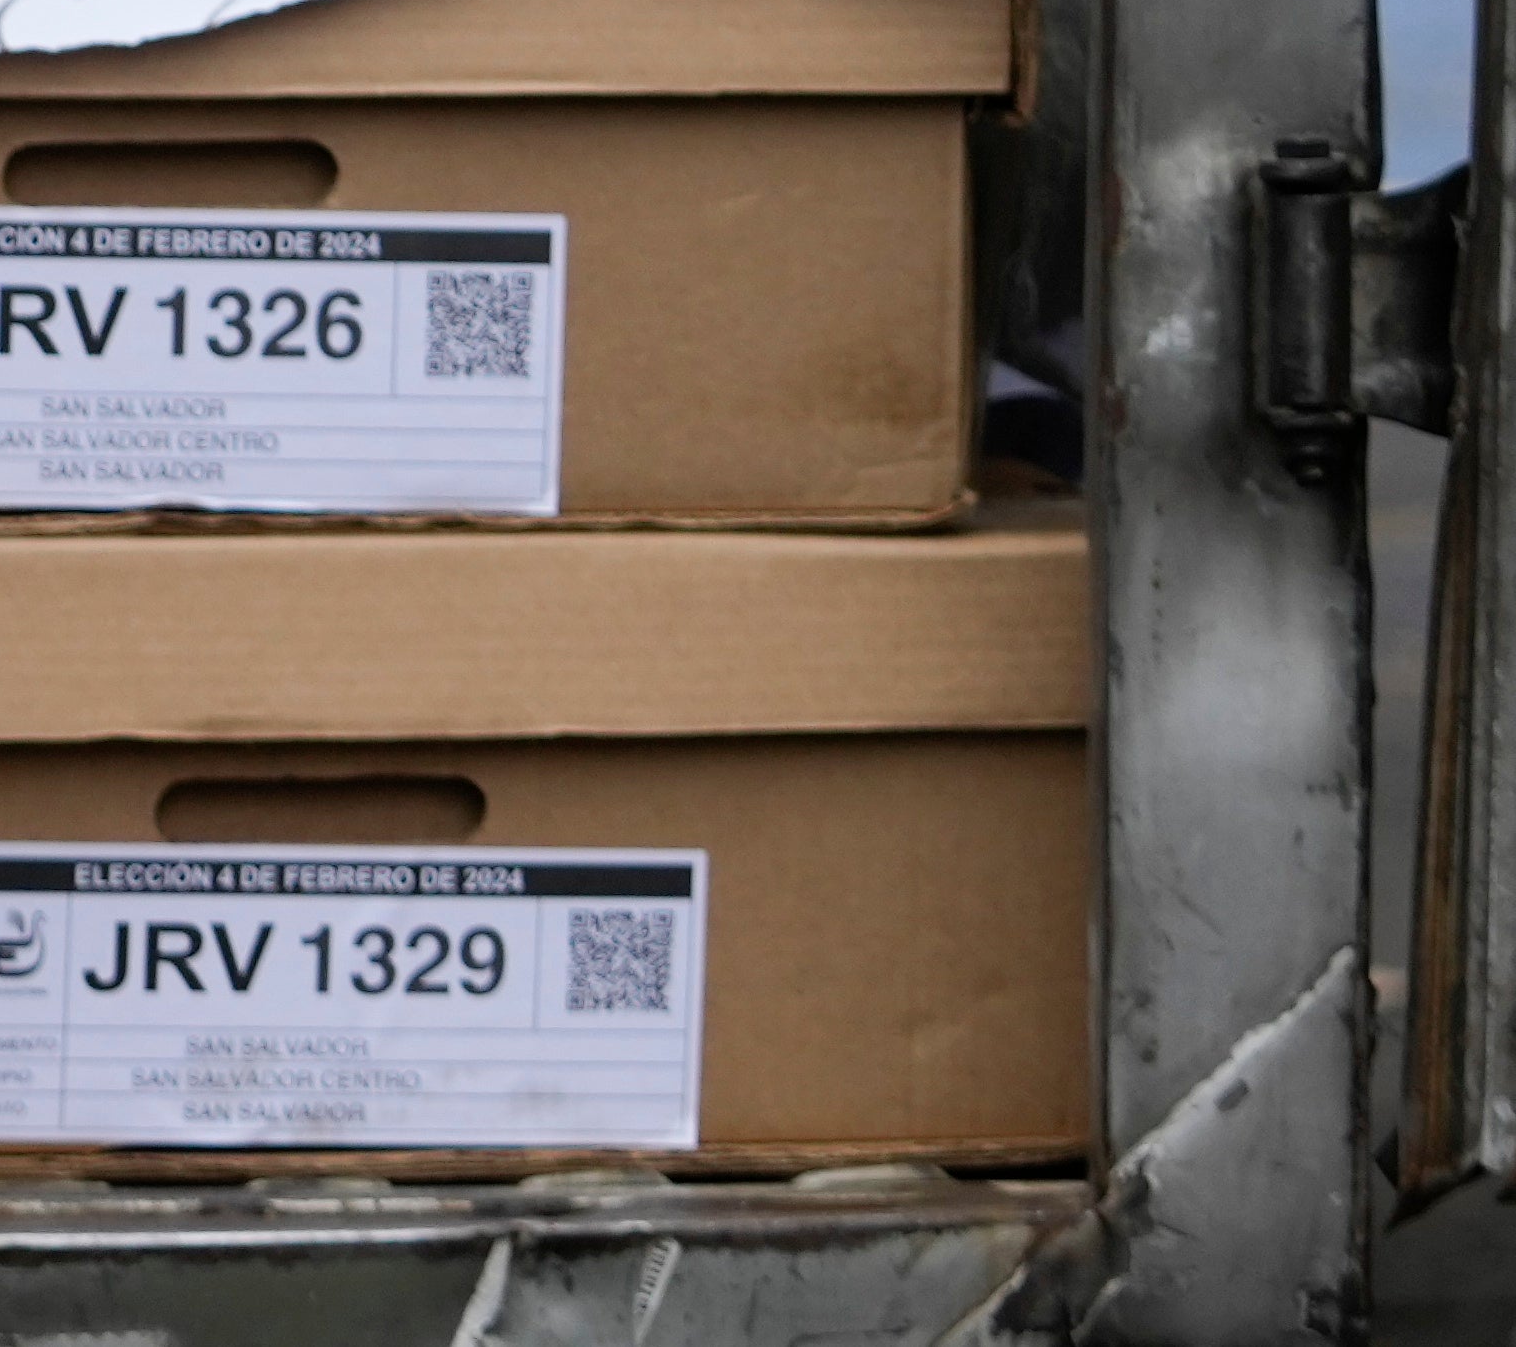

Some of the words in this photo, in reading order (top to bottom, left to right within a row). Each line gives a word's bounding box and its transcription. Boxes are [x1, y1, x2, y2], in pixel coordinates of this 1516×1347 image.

[69, 227, 89, 254] 4
[93, 227, 133, 255] DE
[137, 227, 270, 257] FEBRERO
[274, 229, 316, 258] DE
[319, 231, 382, 259] 2024
[155, 286, 364, 361] 1326
[73, 860, 213, 892] ELECCIÓN
[216, 864, 236, 892] 4
[239, 864, 278, 893] DE
[283, 864, 416, 893] FEBRERO
[418, 865, 456, 894] DE
[460, 865, 526, 894] 2024
[82, 921, 274, 994] JRV
[301, 925, 507, 997] 1329
